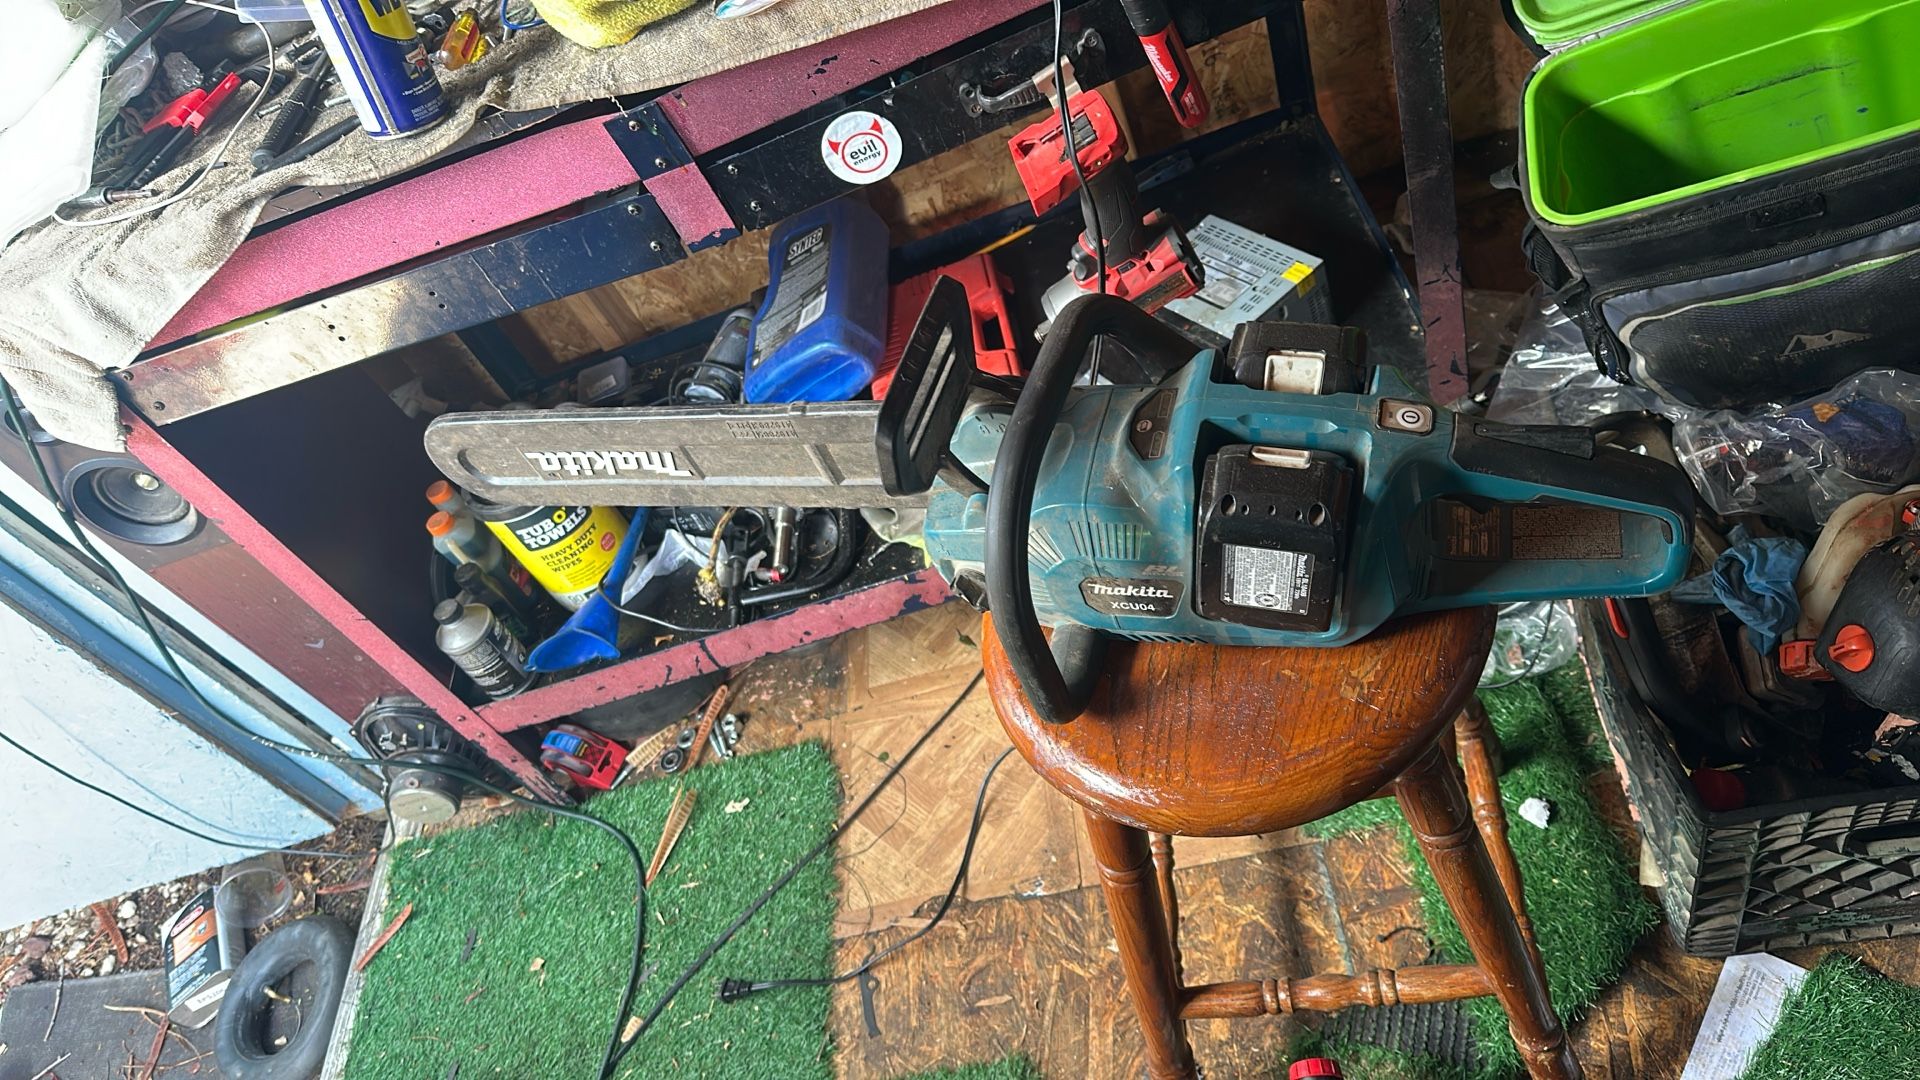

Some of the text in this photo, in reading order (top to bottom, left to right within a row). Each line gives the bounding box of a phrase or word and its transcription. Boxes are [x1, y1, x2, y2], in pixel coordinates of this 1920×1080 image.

[850, 139, 878, 160] evil
[853, 150, 881, 166] energy
[515, 518, 556, 540] TUB
[524, 506, 587, 549] TOWELS
[541, 544, 573, 561] HEAVY
[575, 522, 597, 546] DUTY
[546, 537, 595, 567] CLEANING
[552, 557, 583, 573] WIPES
[1110, 601, 1156, 611] XCU04
